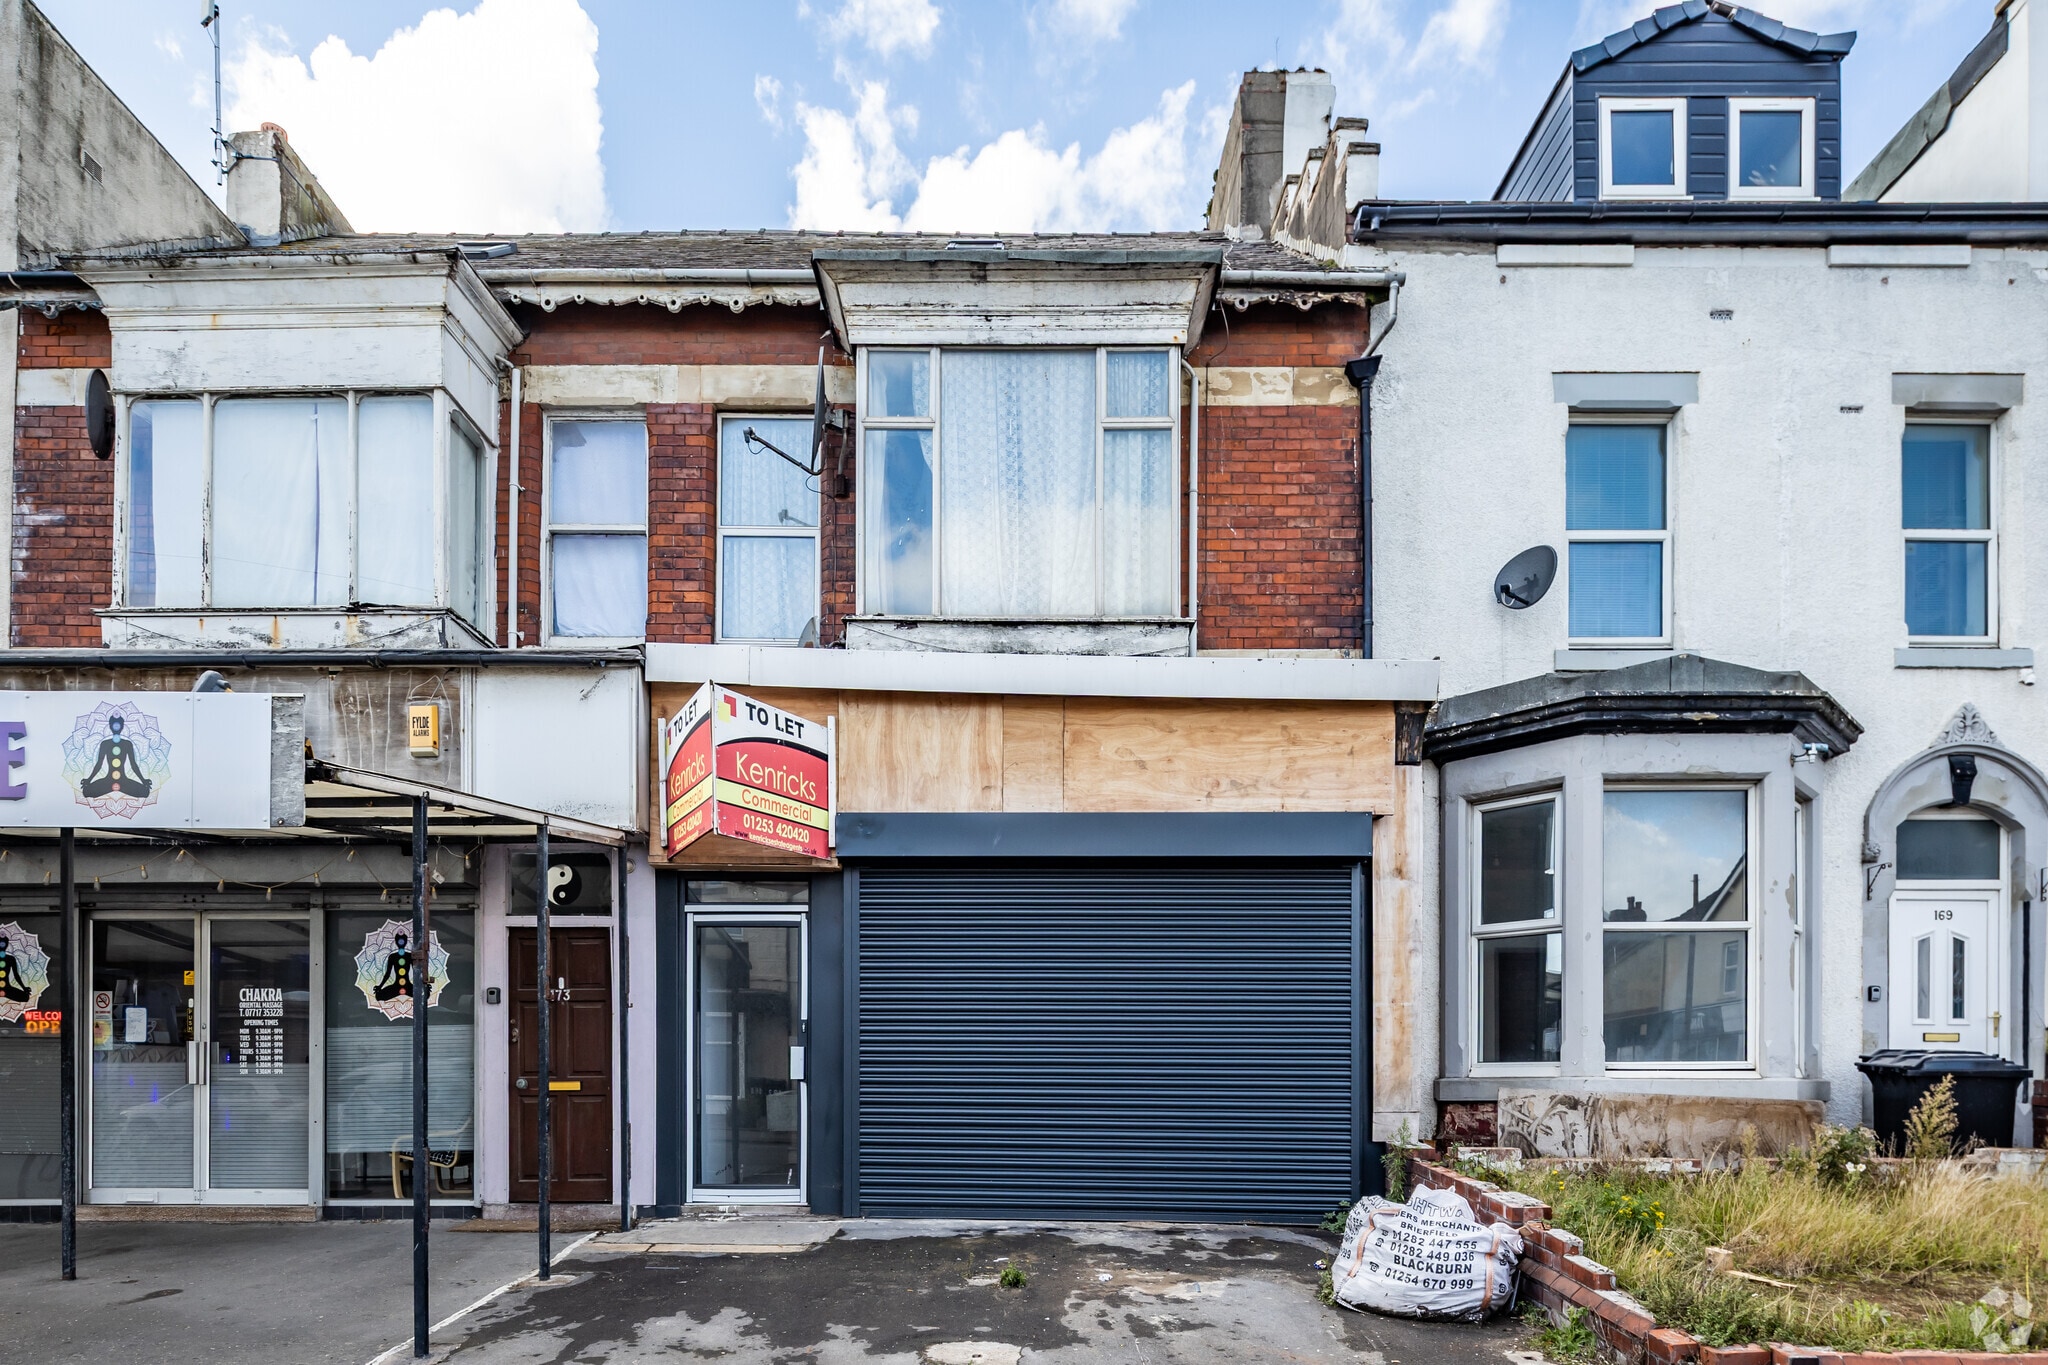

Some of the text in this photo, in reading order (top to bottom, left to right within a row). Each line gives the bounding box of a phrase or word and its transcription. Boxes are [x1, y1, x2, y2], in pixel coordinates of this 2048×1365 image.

[412, 716, 430, 729] FYLDE
[674, 699, 698, 737] TO LET
[745, 701, 805, 739] TO LET
[413, 729, 430, 737] ALARMS
[670, 751, 706, 800] Kenricks
[736, 751, 816, 802] Kenricks
[673, 783, 704, 820] Commercial
[741, 788, 813, 822] Commercial
[743, 813, 810, 844] 01253 420420
[1934, 909, 1953, 921] 169
[239, 988, 283, 1002] CHAKRA
[24, 1011, 62, 1021] WELCO
[186, 1009, 194, 1033] PUSH
[245, 1008, 262, 1017] 07717
[1390, 1241, 1475, 1262] 01282 449 036
[1428, 1238, 1452, 1249] 447
[1455, 1240, 1478, 1250] 555
[1393, 1254, 1473, 1275] BLACKBURN
[1384, 1267, 1474, 1290] 01254 670 999
